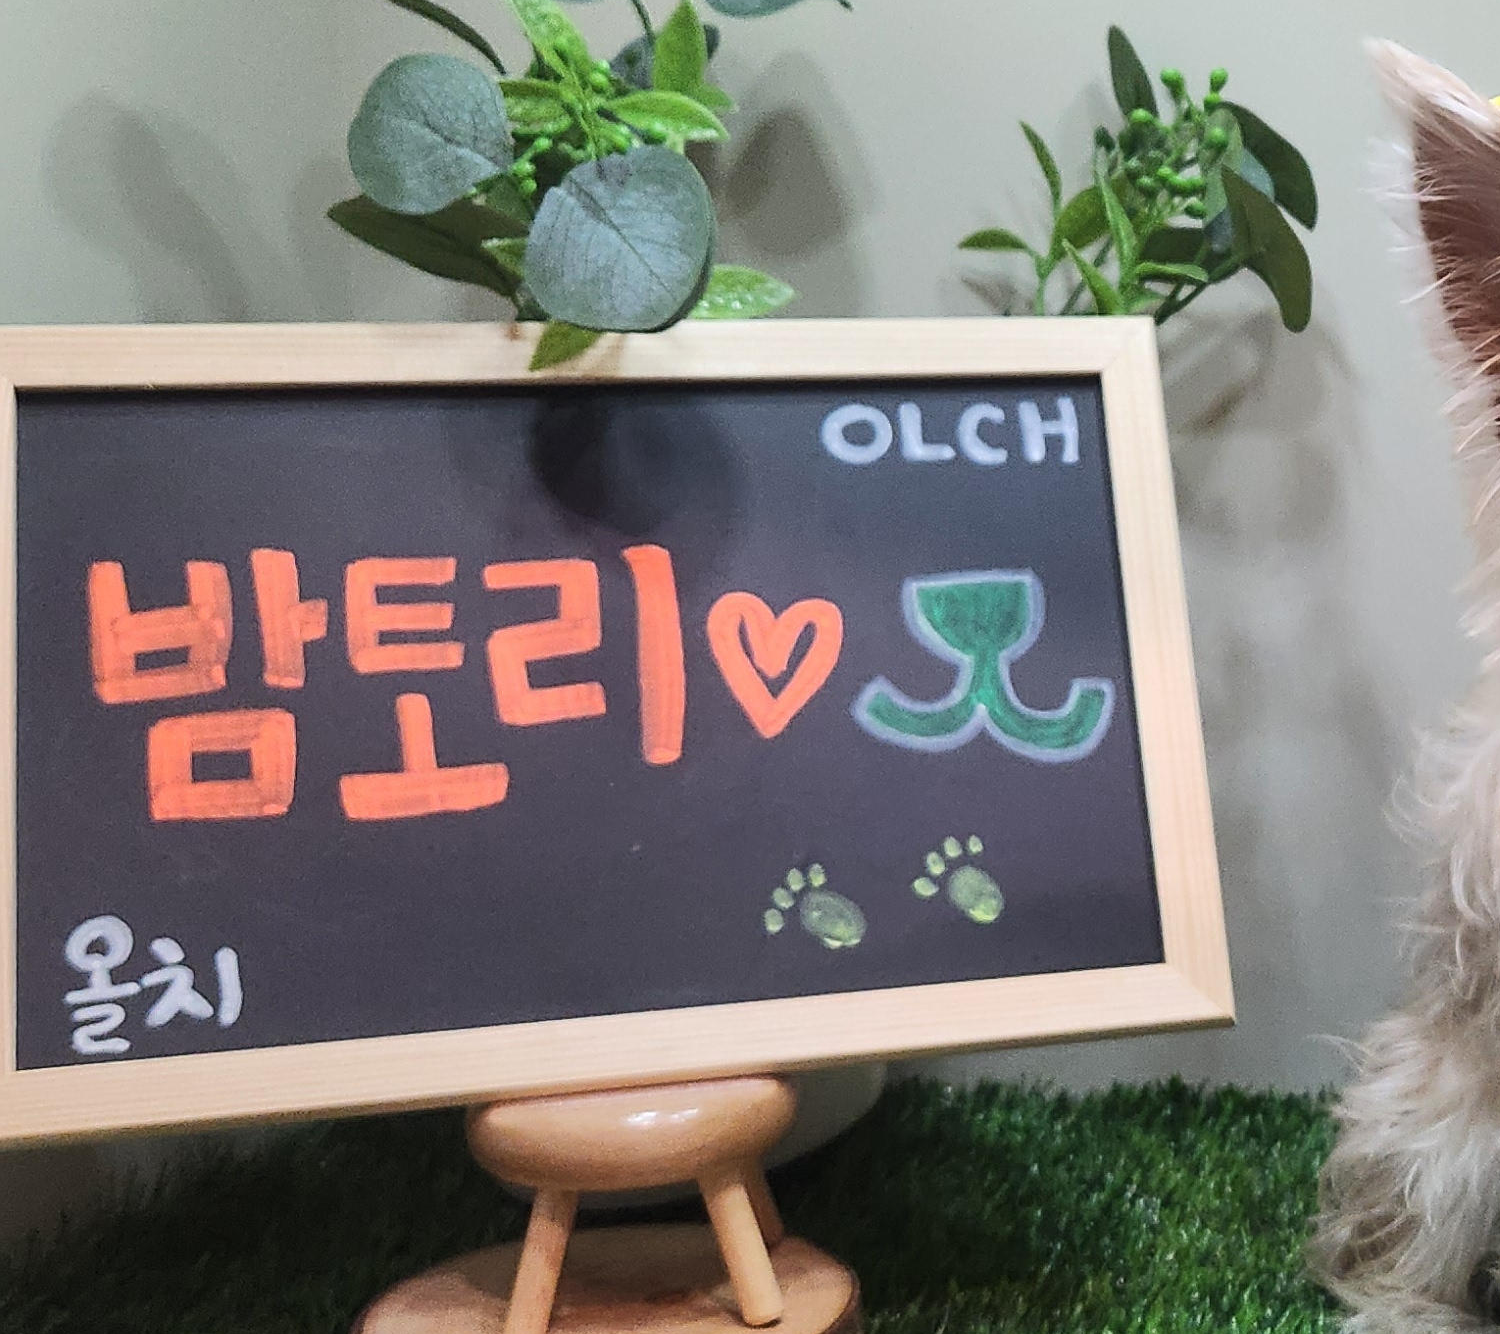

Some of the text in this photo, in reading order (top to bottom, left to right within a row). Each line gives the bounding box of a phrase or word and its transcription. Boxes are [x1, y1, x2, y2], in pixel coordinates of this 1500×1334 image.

[821, 396, 1081, 466] OLCH
[87, 543, 688, 823] 밤토리
[62, 913, 244, 1056] 올치
